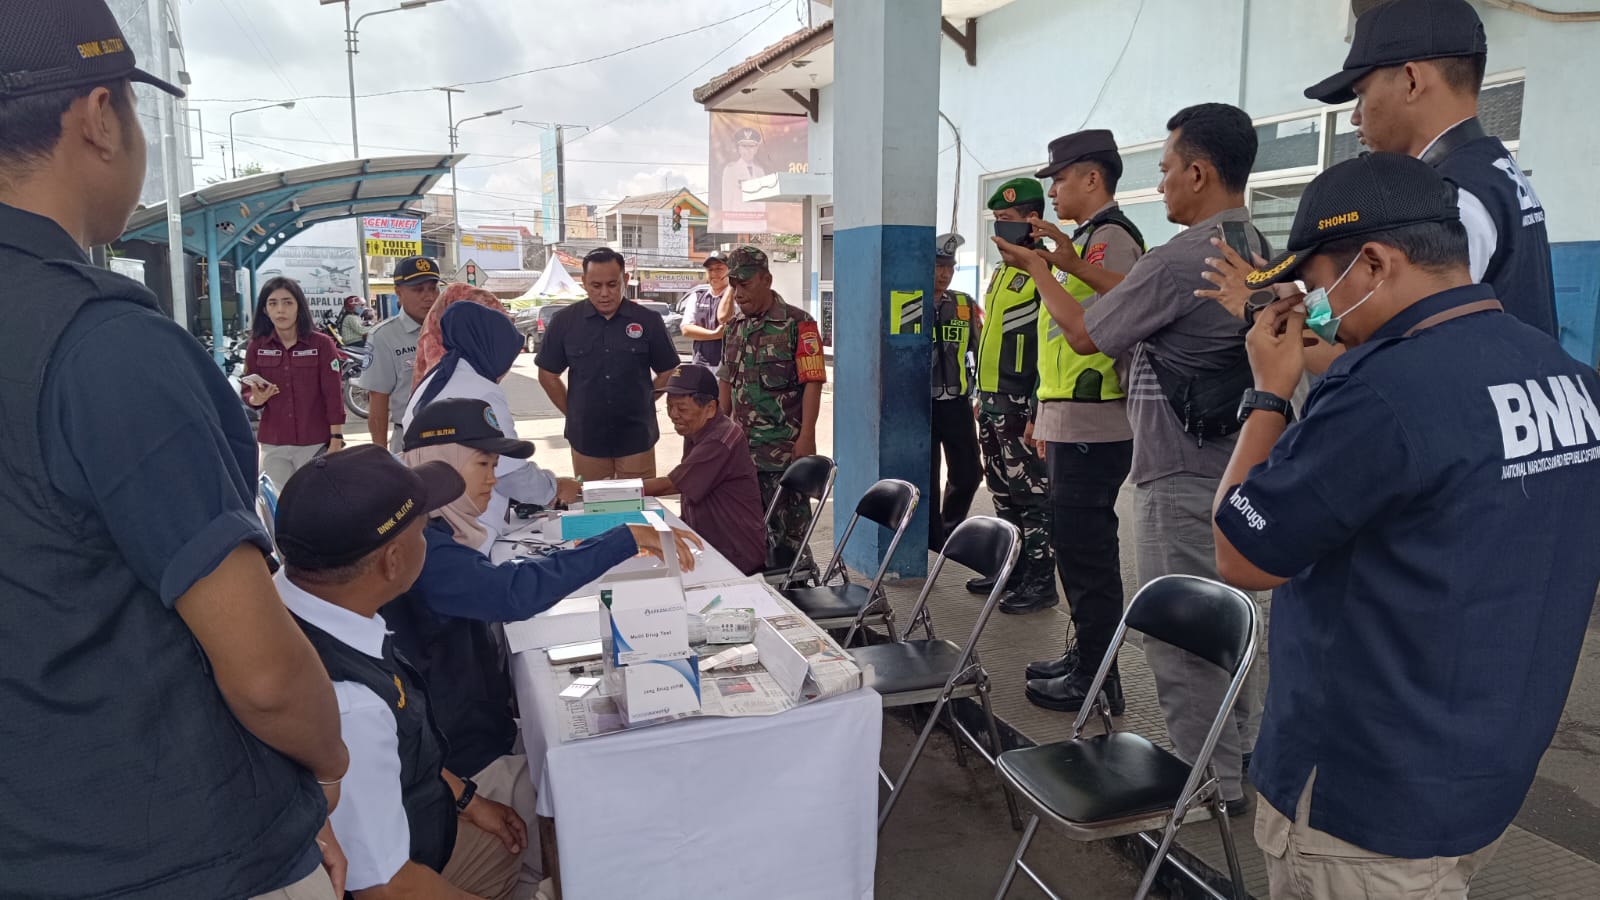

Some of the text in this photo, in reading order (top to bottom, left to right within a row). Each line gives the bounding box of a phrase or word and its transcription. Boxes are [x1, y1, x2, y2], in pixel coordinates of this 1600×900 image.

[390, 219, 417, 229] TIKET
[1318, 211, 1359, 230] SHOHIB
[382, 240, 416, 249] TOILET
[382, 248, 416, 256] UMUM
[333, 298, 345, 306] LA
[1487, 374, 1600, 460] BNN
[1501, 461, 1527, 480] NATIONAL
[1230, 488, 1266, 530] nDrugs
